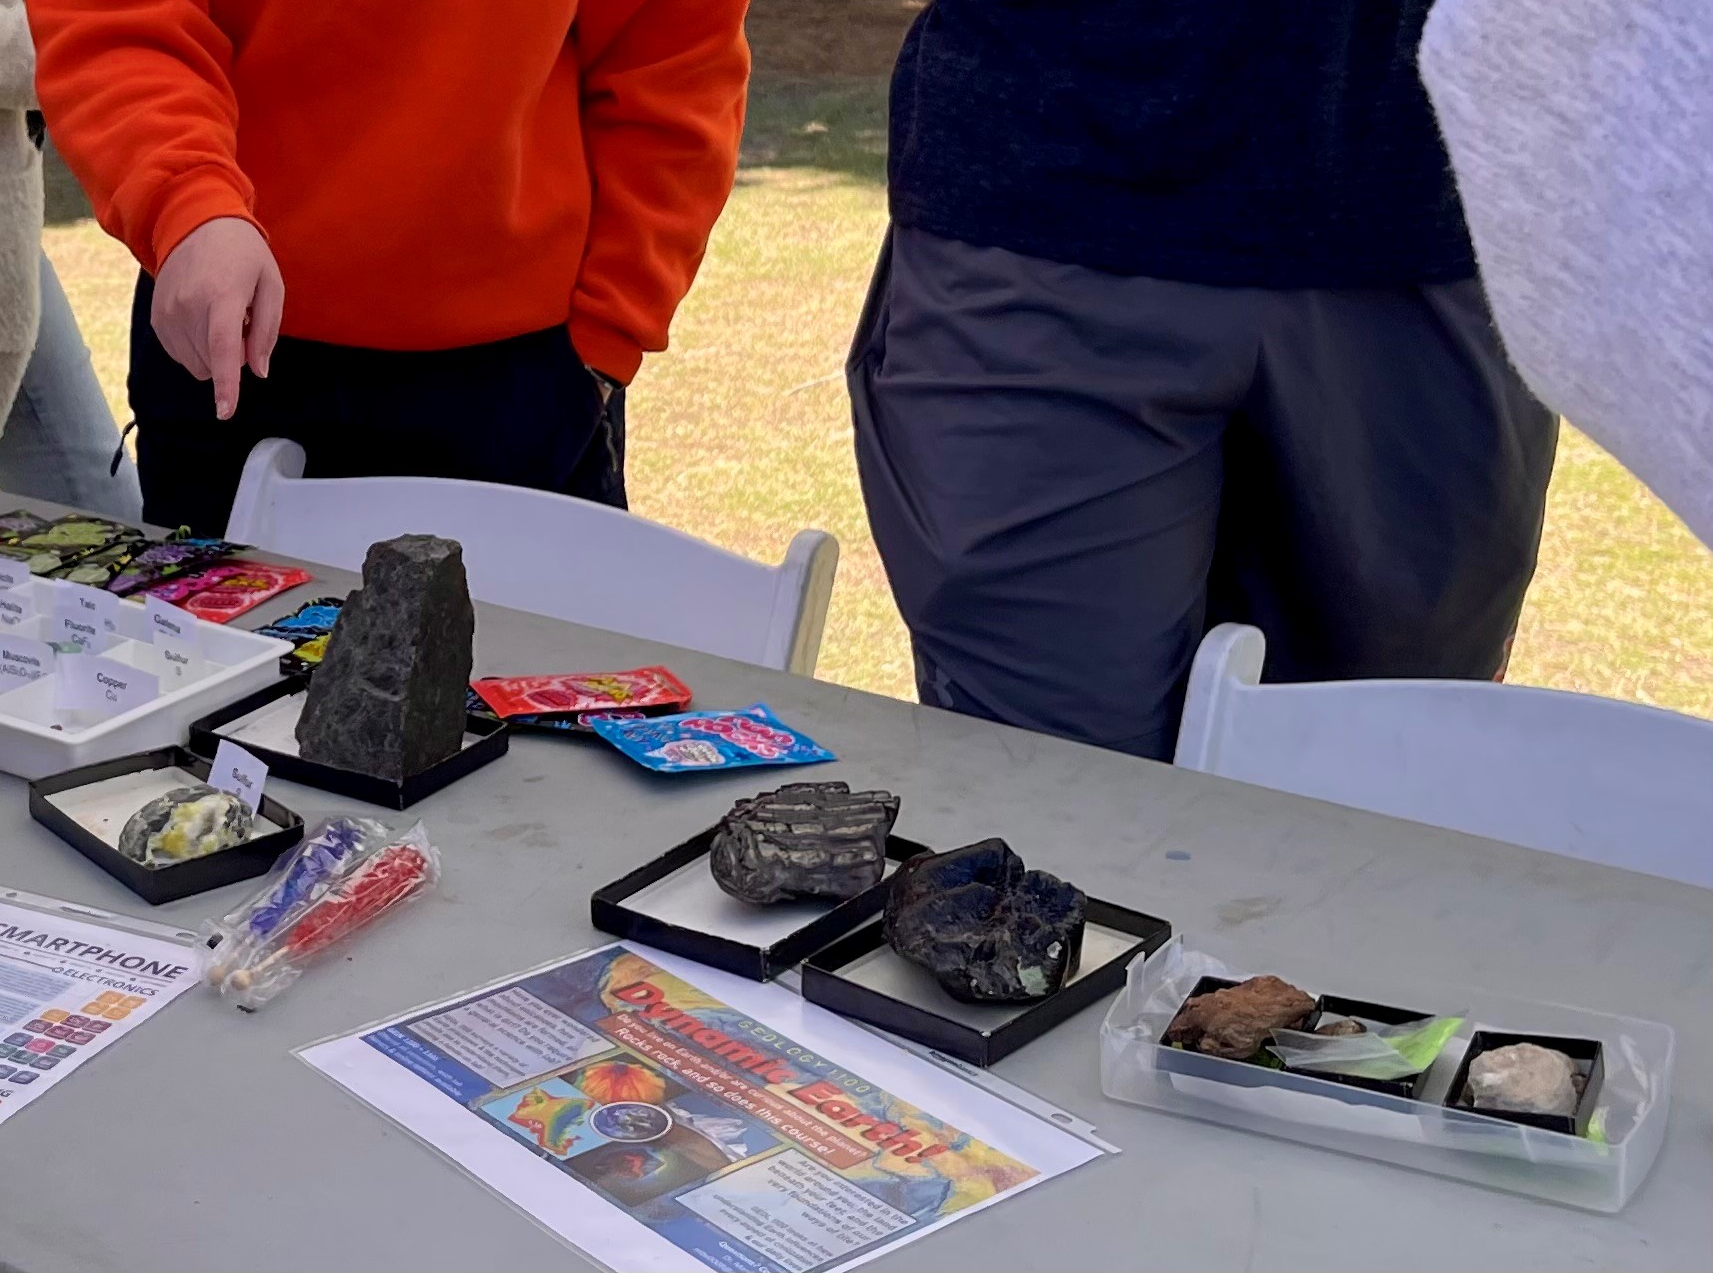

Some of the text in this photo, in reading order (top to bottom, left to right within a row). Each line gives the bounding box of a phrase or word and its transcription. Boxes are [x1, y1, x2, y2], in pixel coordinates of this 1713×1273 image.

[97, 673, 128, 690] Copper
[62, 968, 159, 996] ELECTRONICS
[612, 981, 799, 1085] Dynamic
[788, 1080, 949, 1163] Earth!
[738, 1019, 871, 1093] GEOLOGY 1100
[615, 1028, 653, 1052] Rocks
[684, 1065, 708, 1084] and
[706, 1081, 725, 1094] so
[724, 1089, 754, 1111] does
[755, 1103, 784, 1126] this
[781, 1124, 837, 1155] course!
[799, 1161, 815, 1170] Are
[814, 1172, 832, 1181] you
[892, 1214, 907, 1224] the
